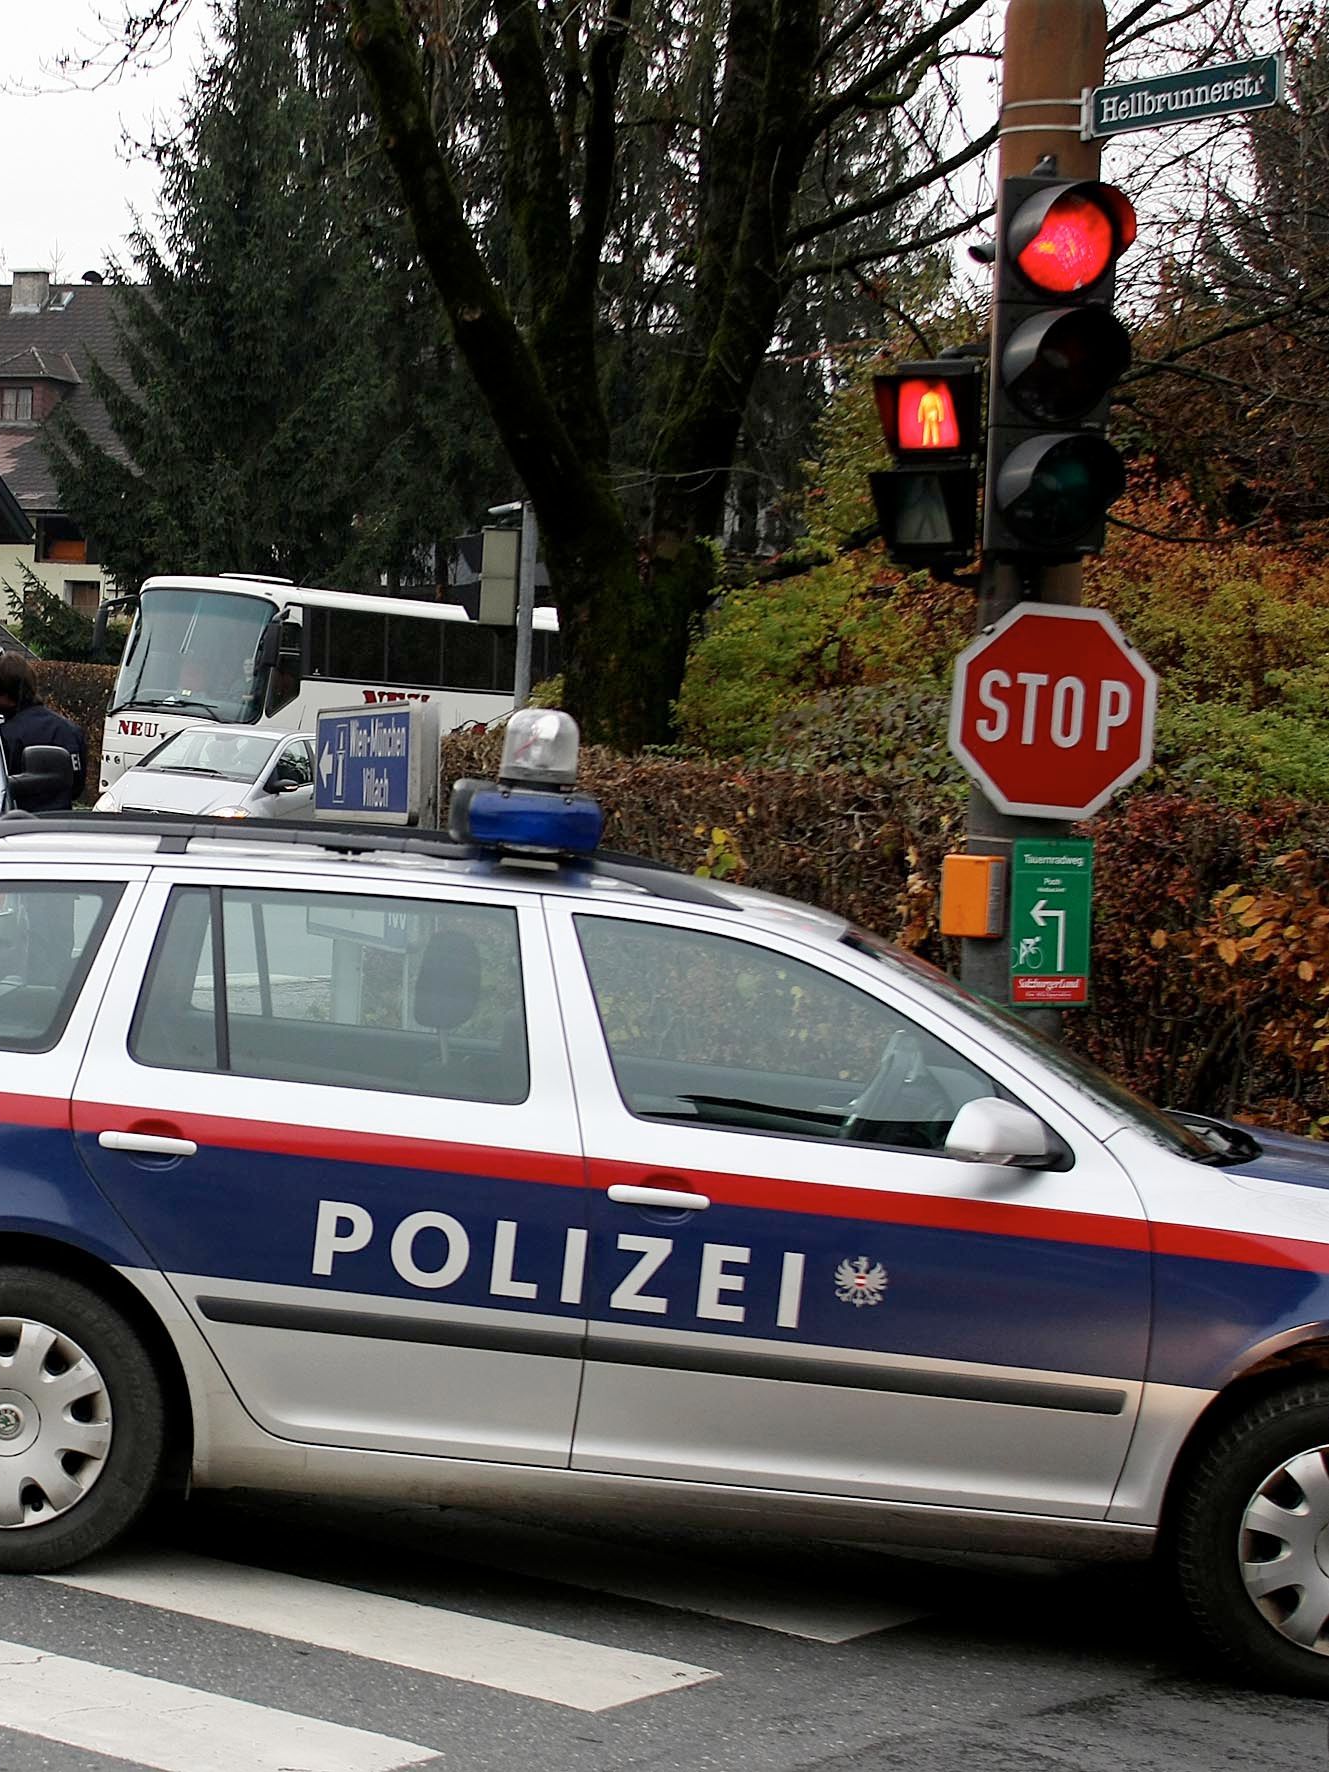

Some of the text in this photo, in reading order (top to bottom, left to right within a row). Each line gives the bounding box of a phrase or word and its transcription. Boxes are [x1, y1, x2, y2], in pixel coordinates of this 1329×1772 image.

[117, 719, 159, 738] NEU
[975, 669, 1131, 752] STOP
[349, 717, 406, 758] Wien-München
[362, 767, 389, 808] Villach
[1023, 854, 1085, 868] Tauernradweg
[311, 1199, 806, 1329] POLIZEI
